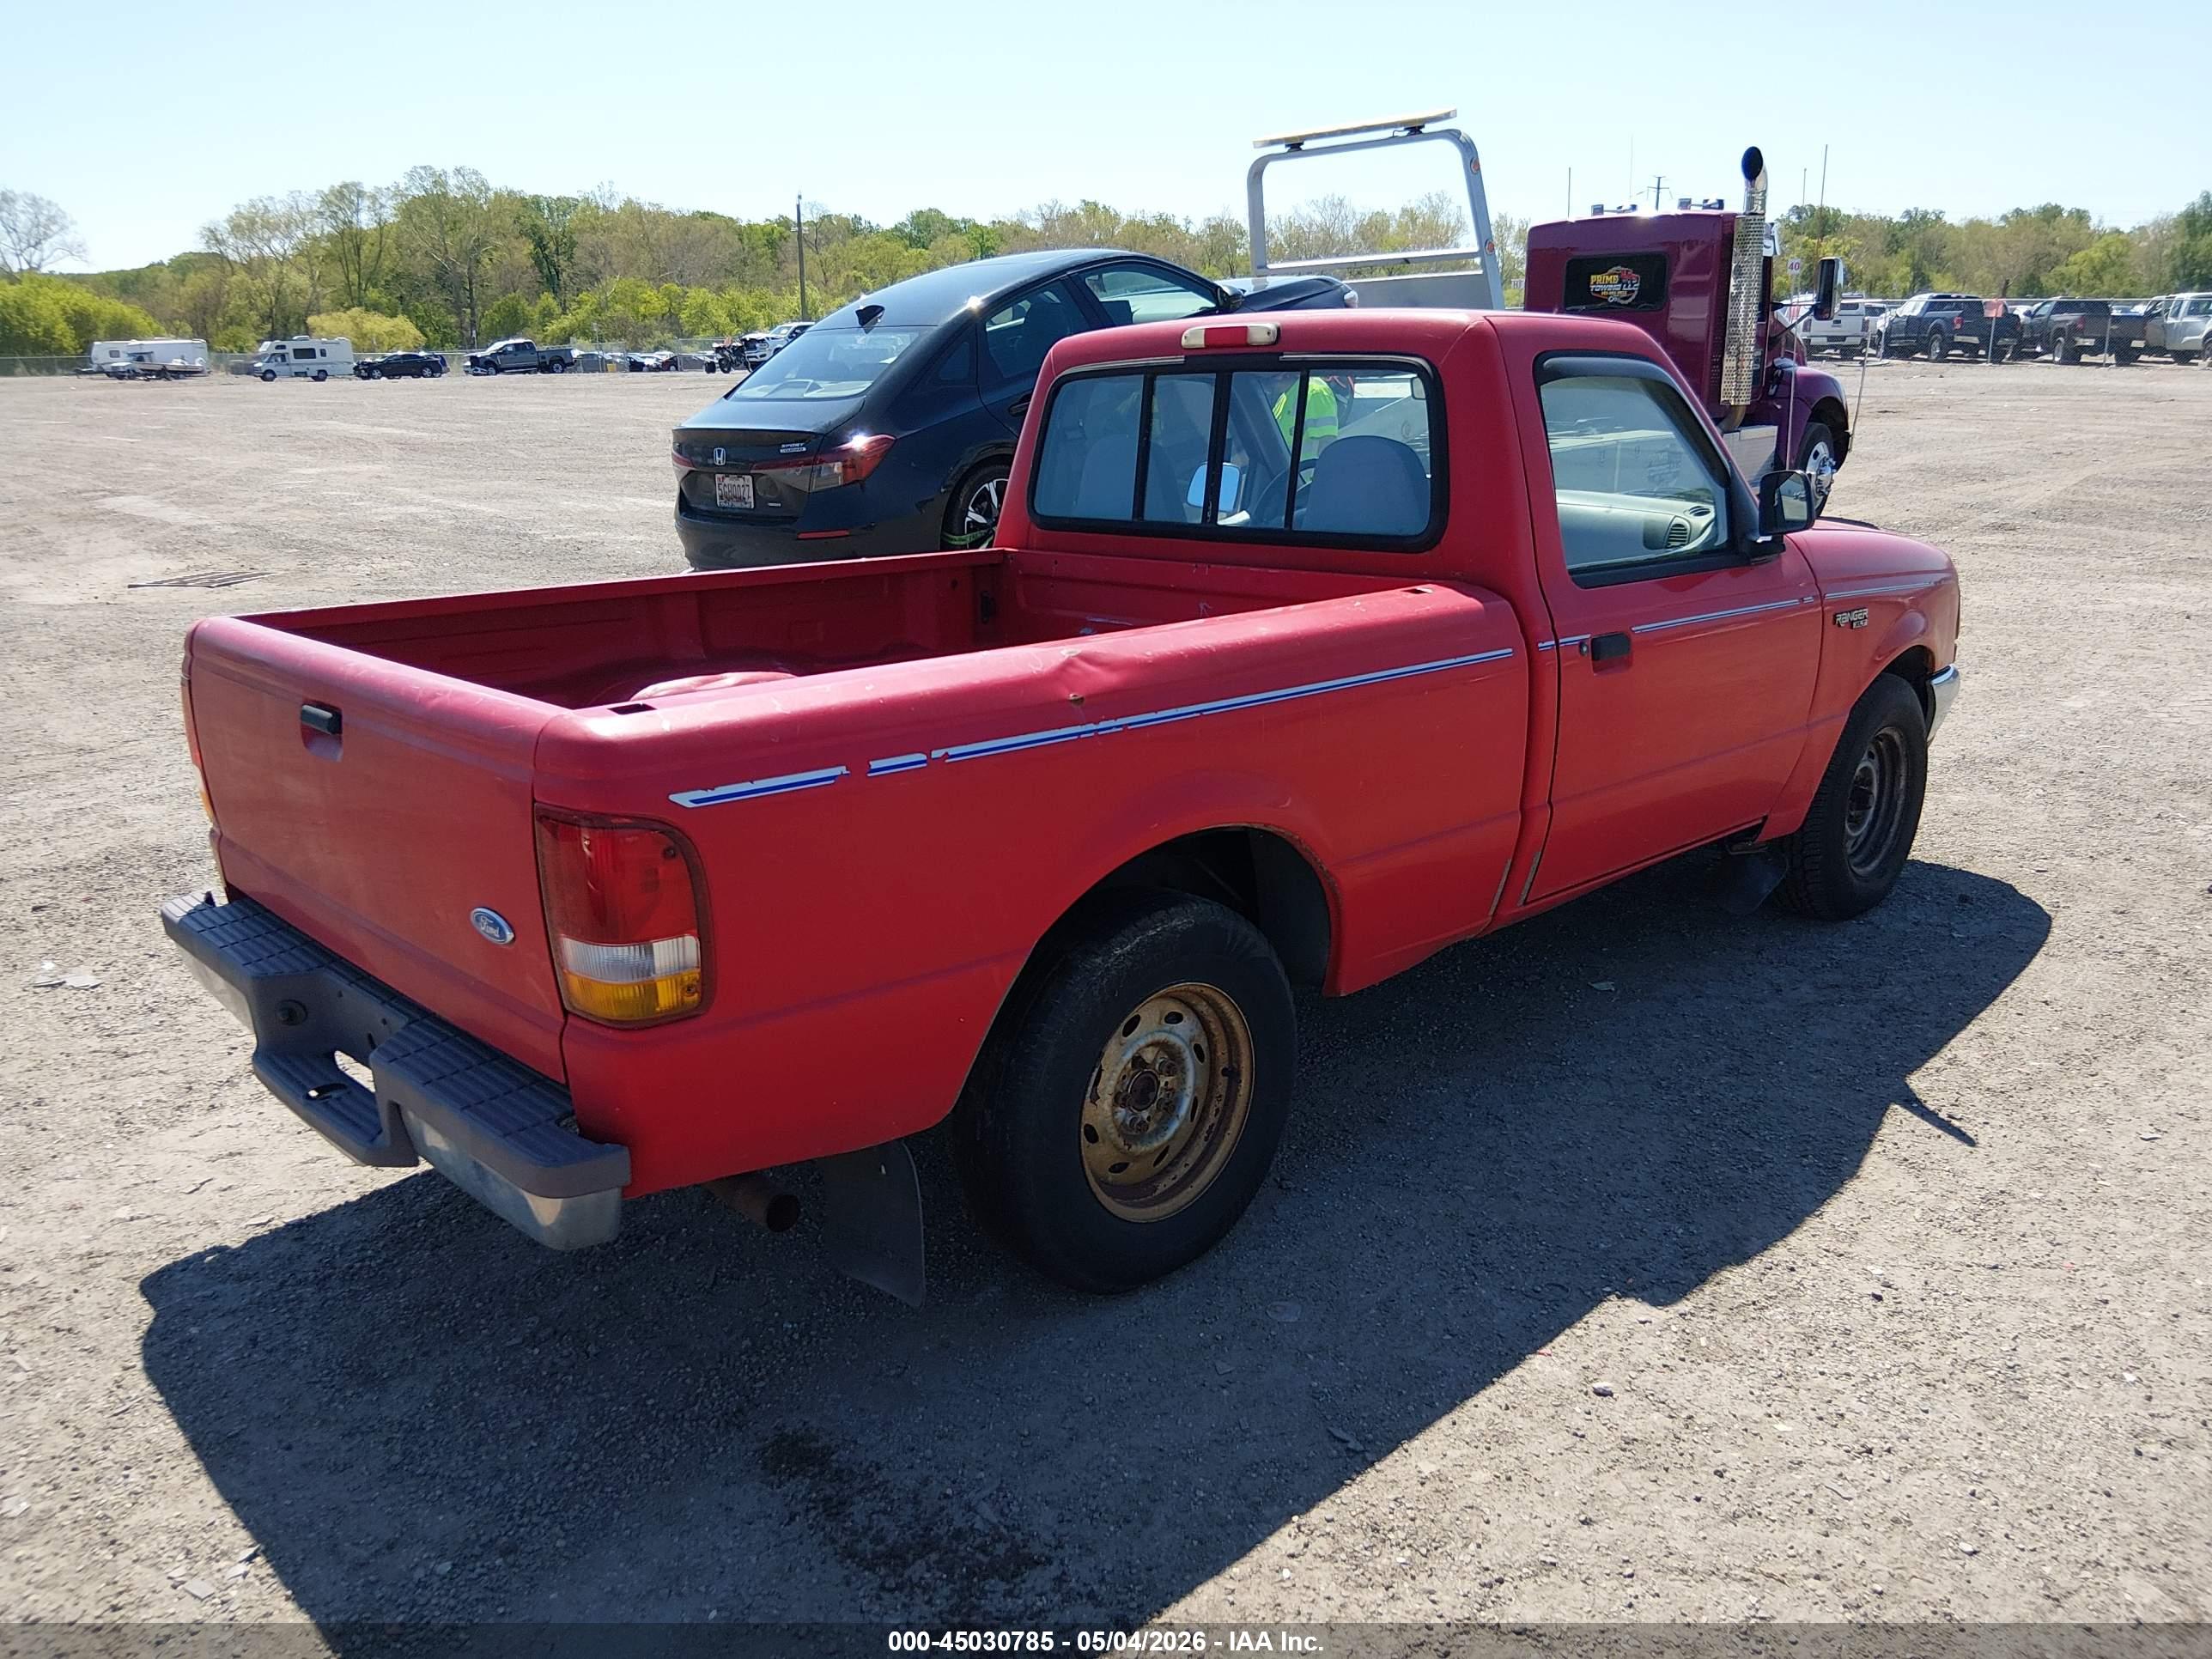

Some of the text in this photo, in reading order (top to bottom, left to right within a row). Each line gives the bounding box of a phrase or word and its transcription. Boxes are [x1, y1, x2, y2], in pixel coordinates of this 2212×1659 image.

[1789, 262, 1800, 271] 40
[1835, 608, 1869, 627] RANGER
[480, 915, 500, 938] Ford
